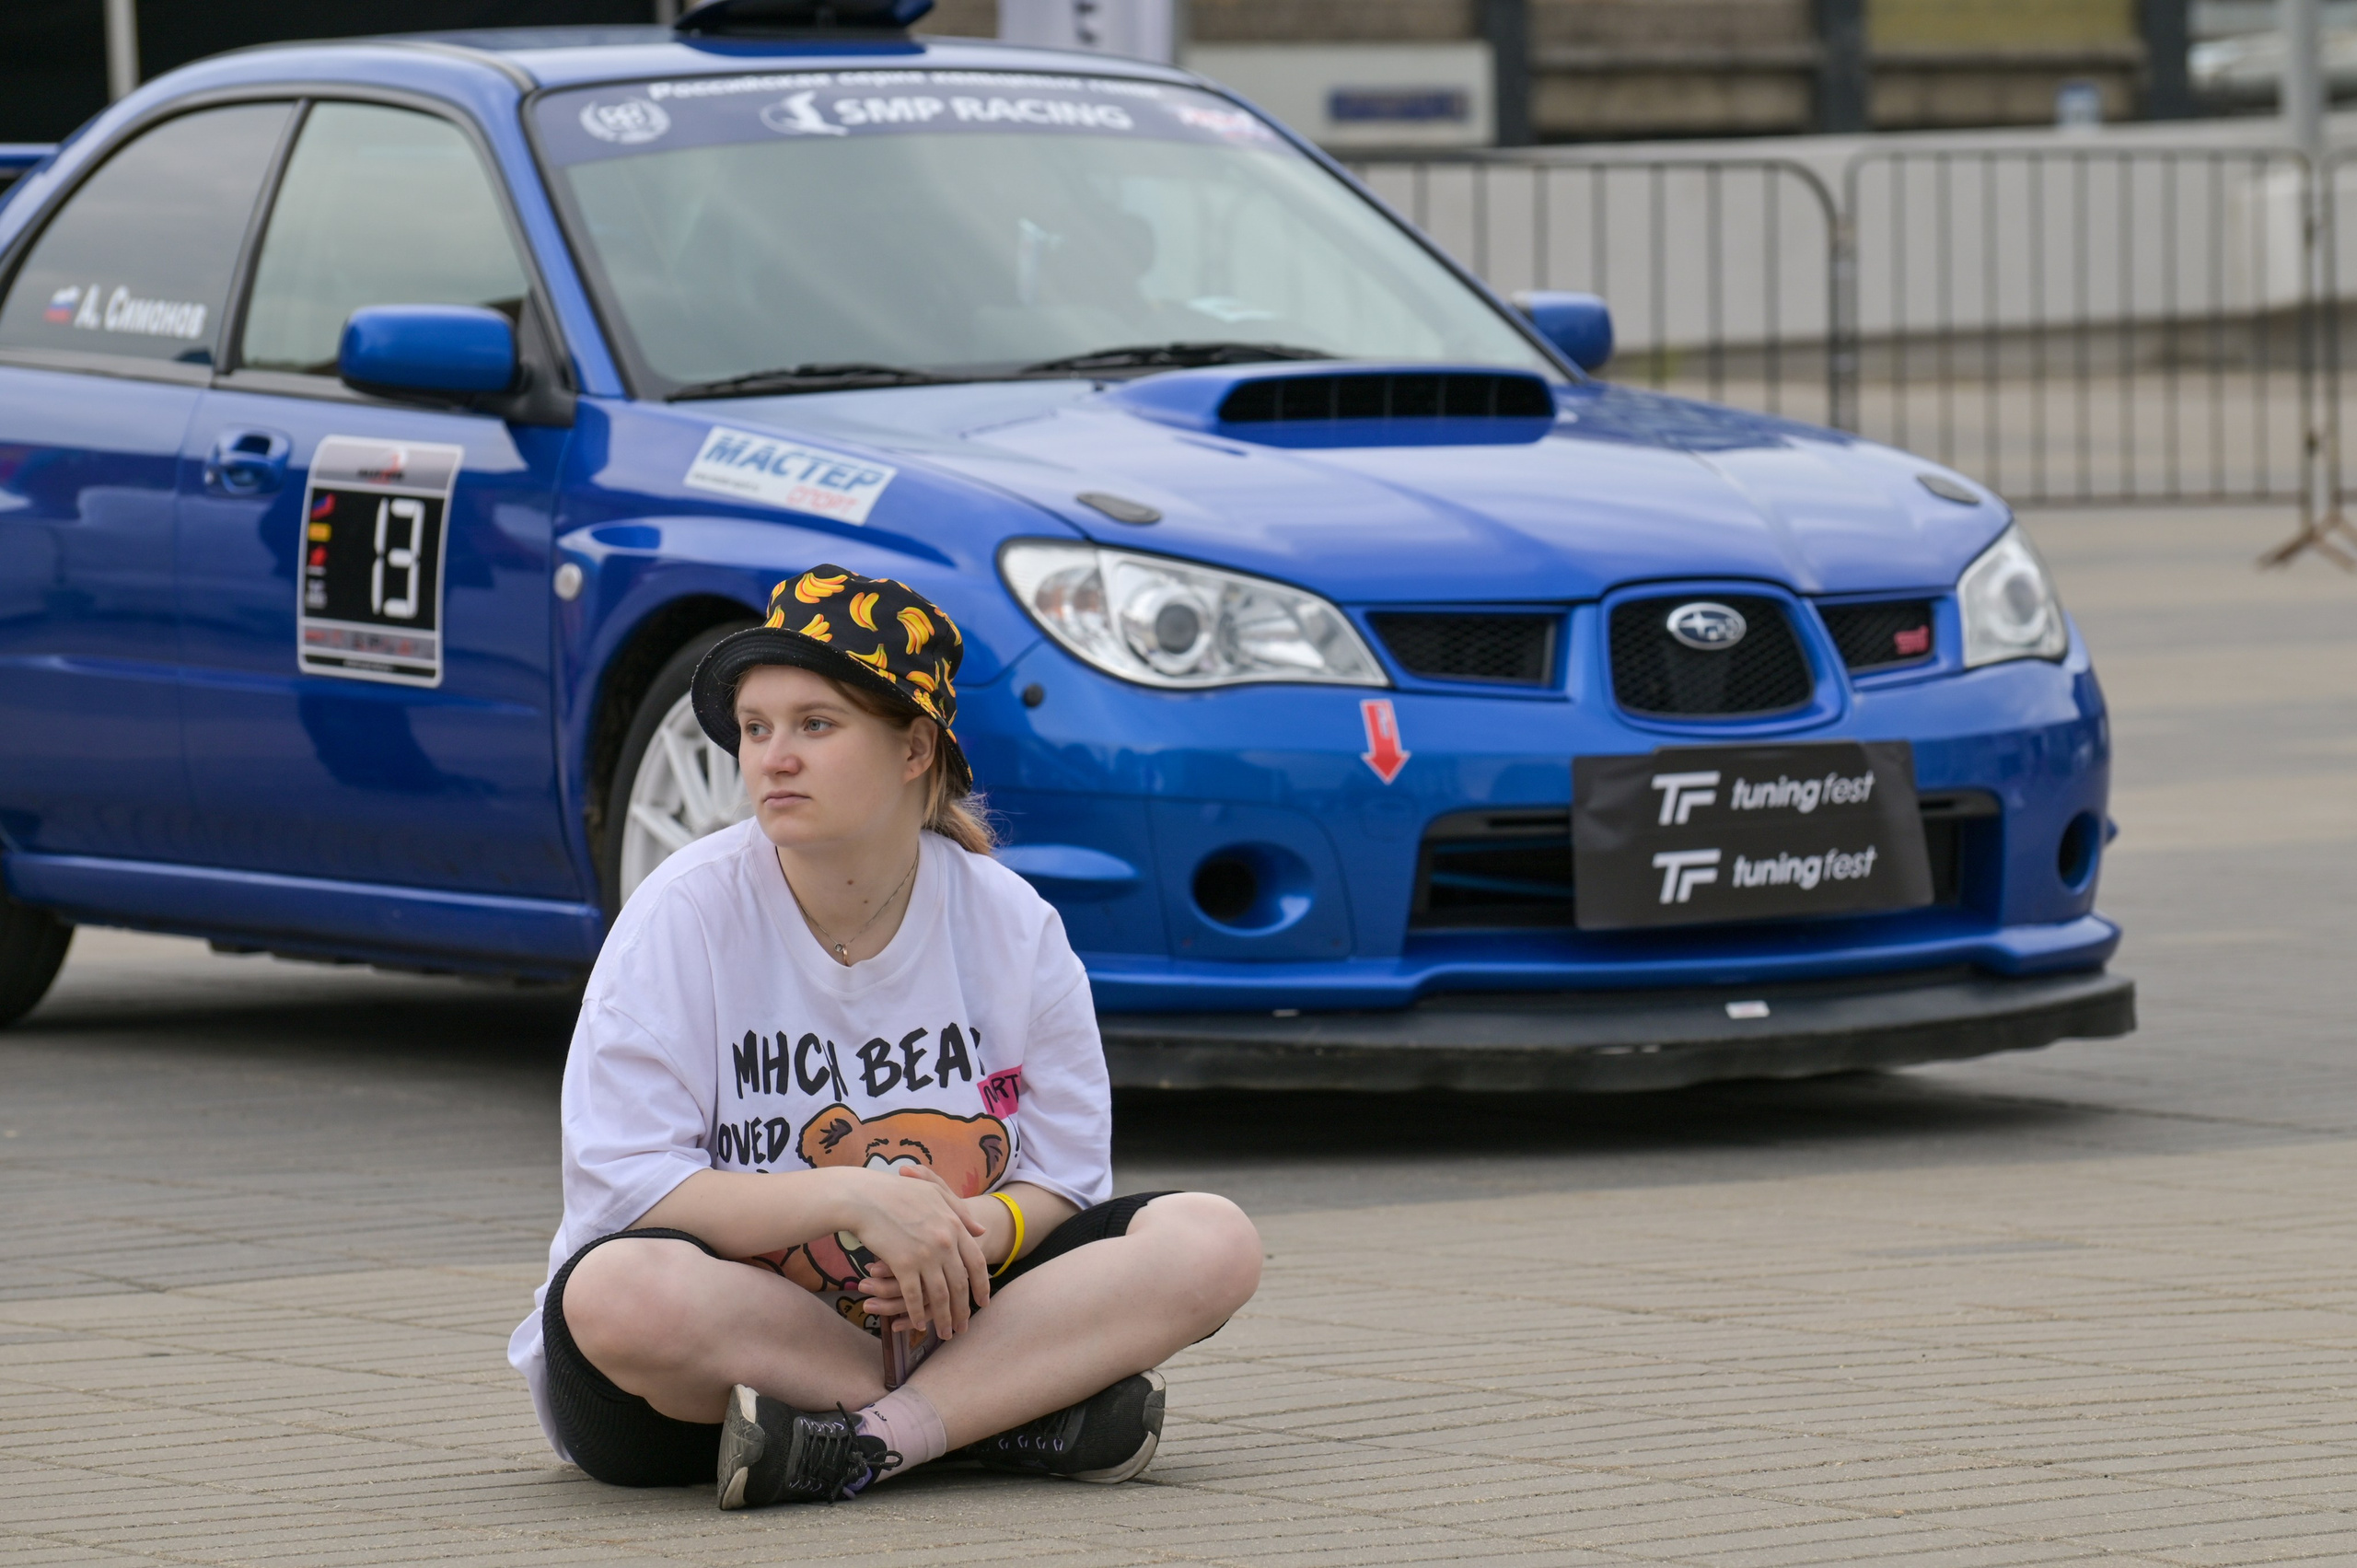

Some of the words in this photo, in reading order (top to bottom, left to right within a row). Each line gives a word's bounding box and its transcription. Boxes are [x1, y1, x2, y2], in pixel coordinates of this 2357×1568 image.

[833, 96, 945, 126] SMP
[949, 96, 1135, 131] RACING
[104, 285, 208, 340] Симонов
[704, 434, 888, 493] МАСТЕР
[371, 497, 425, 619] 13
[1651, 771, 1721, 827] TF
[1652, 848, 1722, 905] TF
[855, 1022, 986, 1098] BEA
[717, 1116, 791, 1167] OVED
